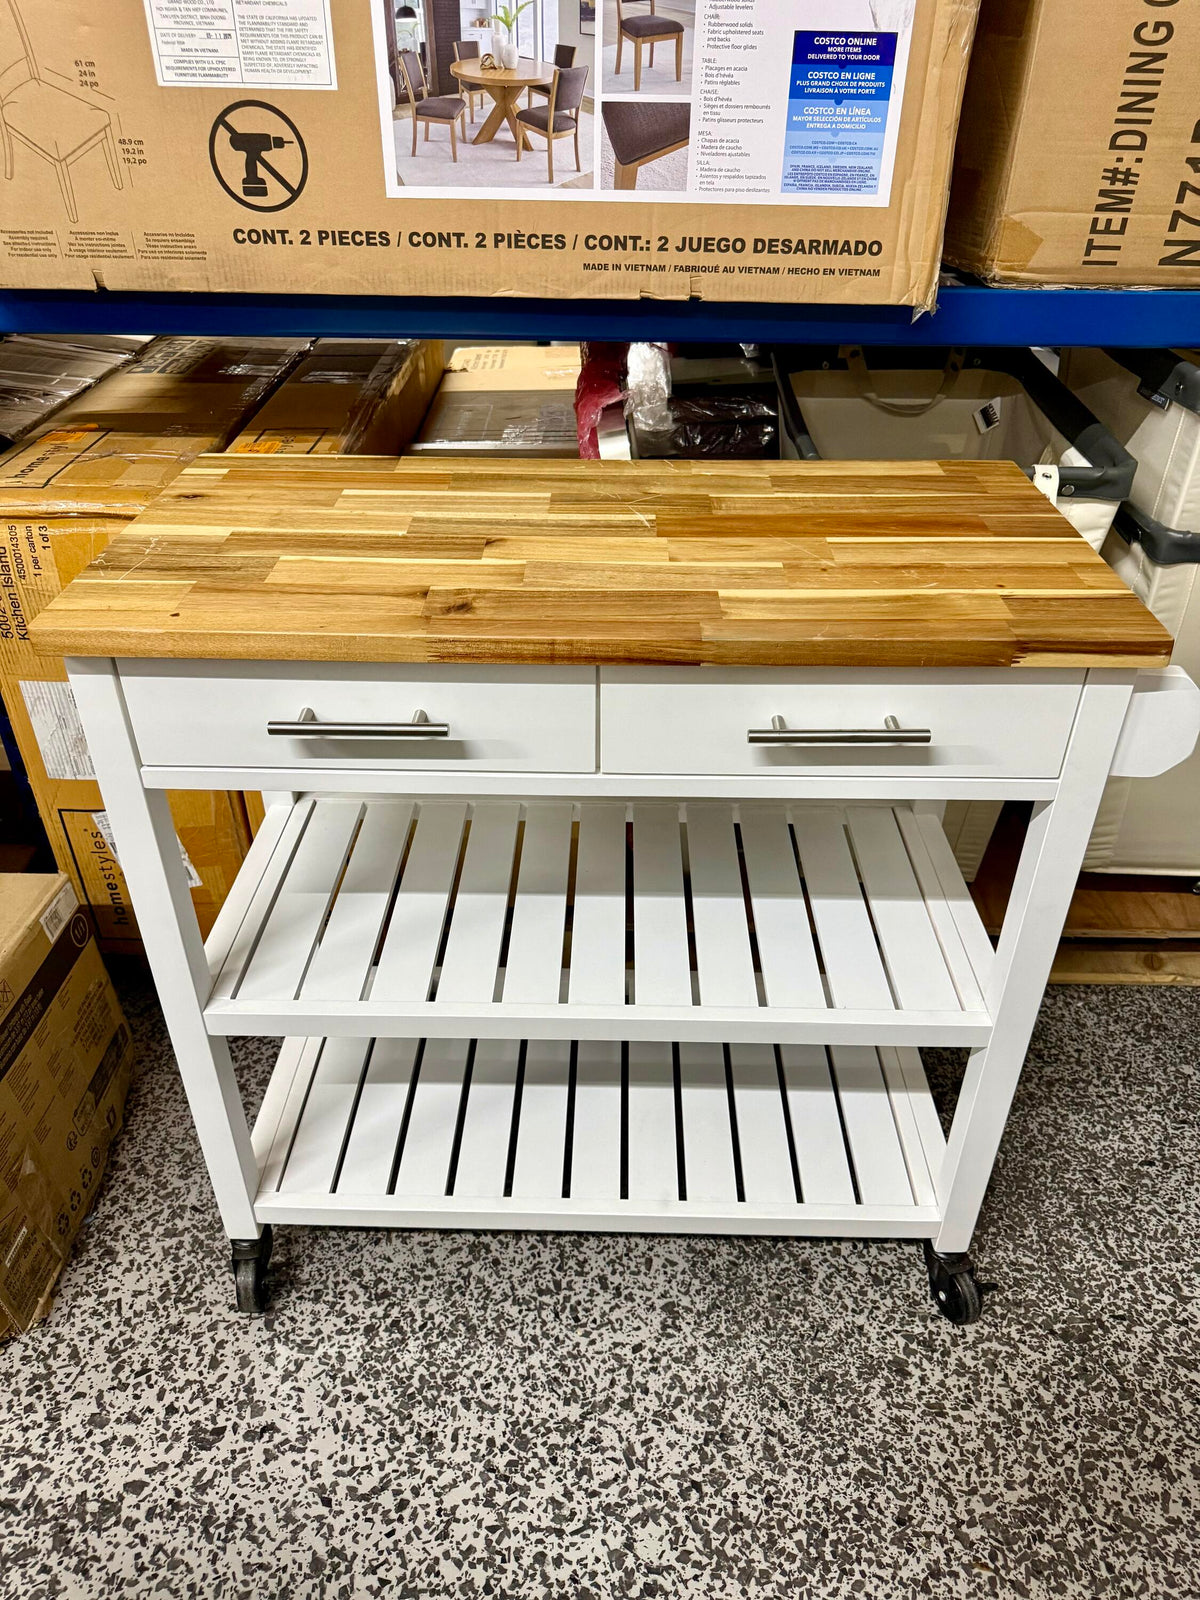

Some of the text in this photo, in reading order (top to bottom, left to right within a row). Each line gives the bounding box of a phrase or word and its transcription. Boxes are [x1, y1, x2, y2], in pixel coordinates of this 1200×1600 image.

[849, 106, 871, 115] LÍNEA
[233, 228, 293, 245] CONT.
[300, 230, 311, 245] 2
[318, 230, 390, 247] PIECES
[408, 232, 468, 249] CONT.
[475, 233, 486, 249] 2
[493, 230, 566, 250] PIÈCES
[584, 235, 650, 252] CONT.:
[657, 236, 669, 252] 2
[675, 236, 746, 254] JUEGO
[753, 238, 883, 257] DESARMADO
[624, 264, 666, 272] VIETNAM
[674, 263, 720, 274] FABRIQUÉ
[738, 266, 780, 275] VIETNAM
[787, 268, 820, 276] HECHO
[823, 268, 835, 276] EN
[838, 268, 881, 277] VIETNAM
[26, 526, 36, 553] carton
[41, 533, 50, 542] of
[8, 525, 26, 580] 4500014305
[32, 557, 42, 570] per
[0, 546, 30, 640] Kitchen Island
[90, 830, 129, 925] homestyles
